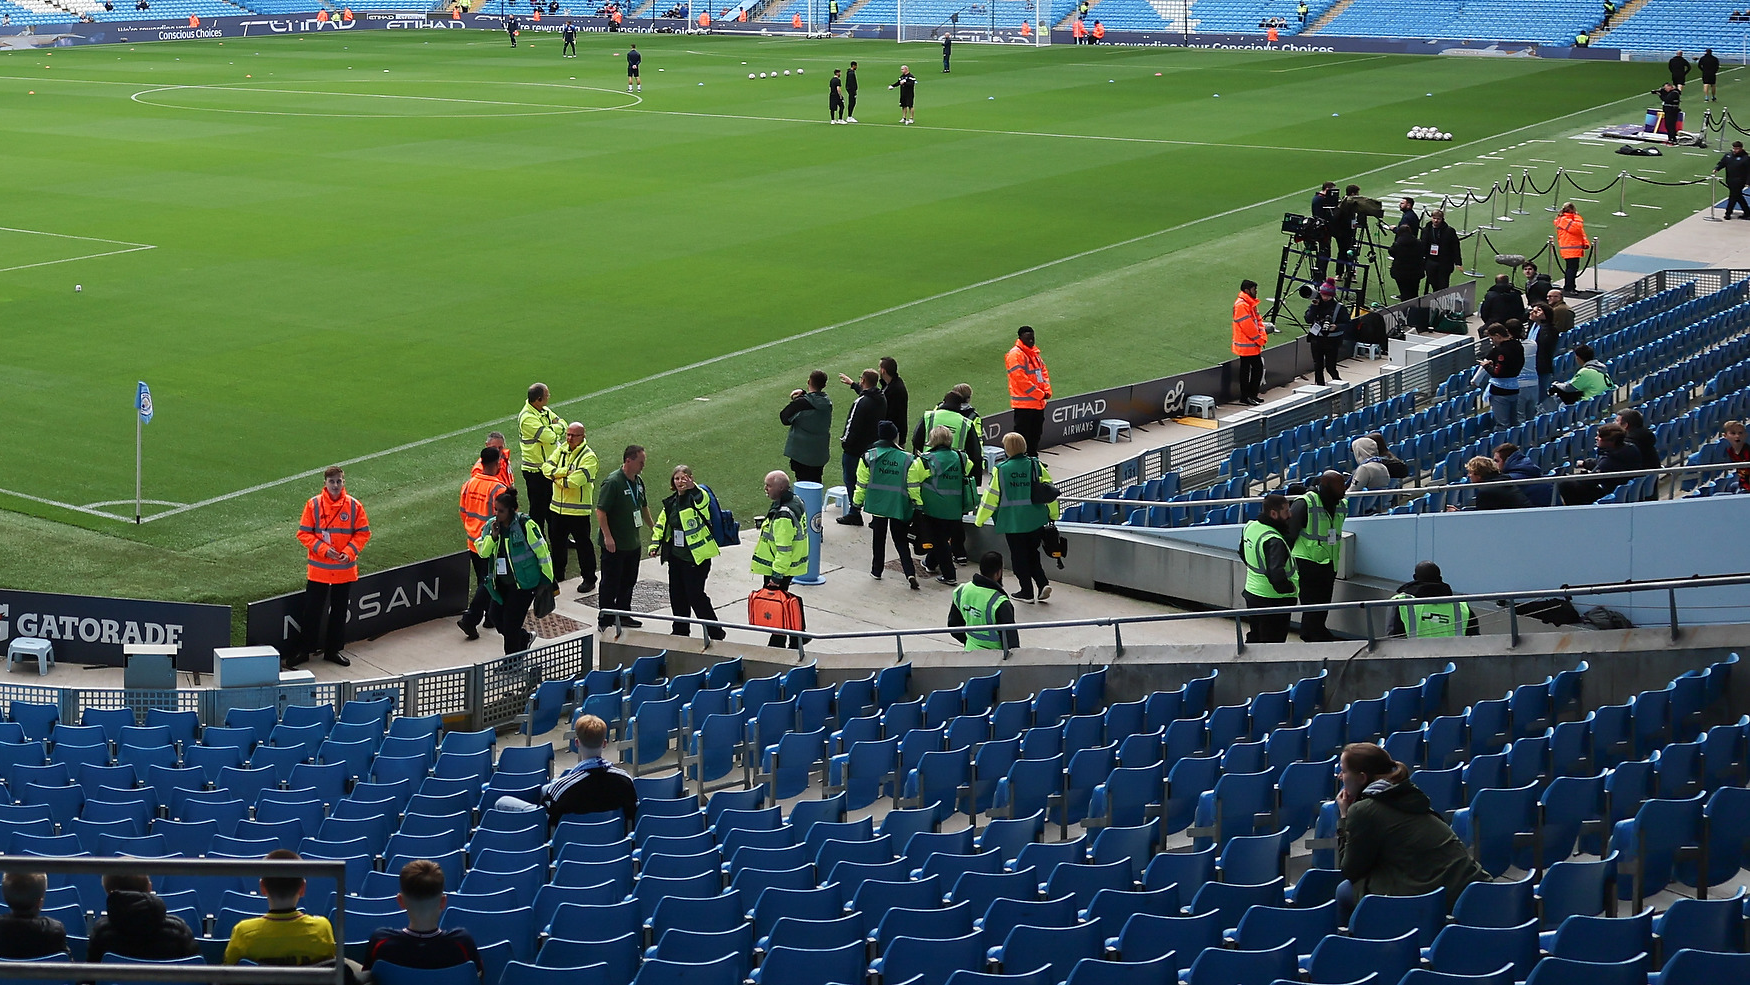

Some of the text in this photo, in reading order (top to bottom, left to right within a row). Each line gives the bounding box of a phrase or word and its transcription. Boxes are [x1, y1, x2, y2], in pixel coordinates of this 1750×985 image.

[386, 20, 466, 30] ETIHAD
[158, 28, 223, 40] Conscious Choices
[1052, 398, 1107, 424] ETIHAD
[1062, 421, 1095, 438] AIRWAYS
[881, 459, 899, 468] Club
[1010, 472, 1028, 480] Club
[1009, 480, 1031, 489] Nurse
[283, 578, 441, 641] NSSAN
[17, 613, 184, 649] GATORADE
[372, 690, 386, 699] Aisle
